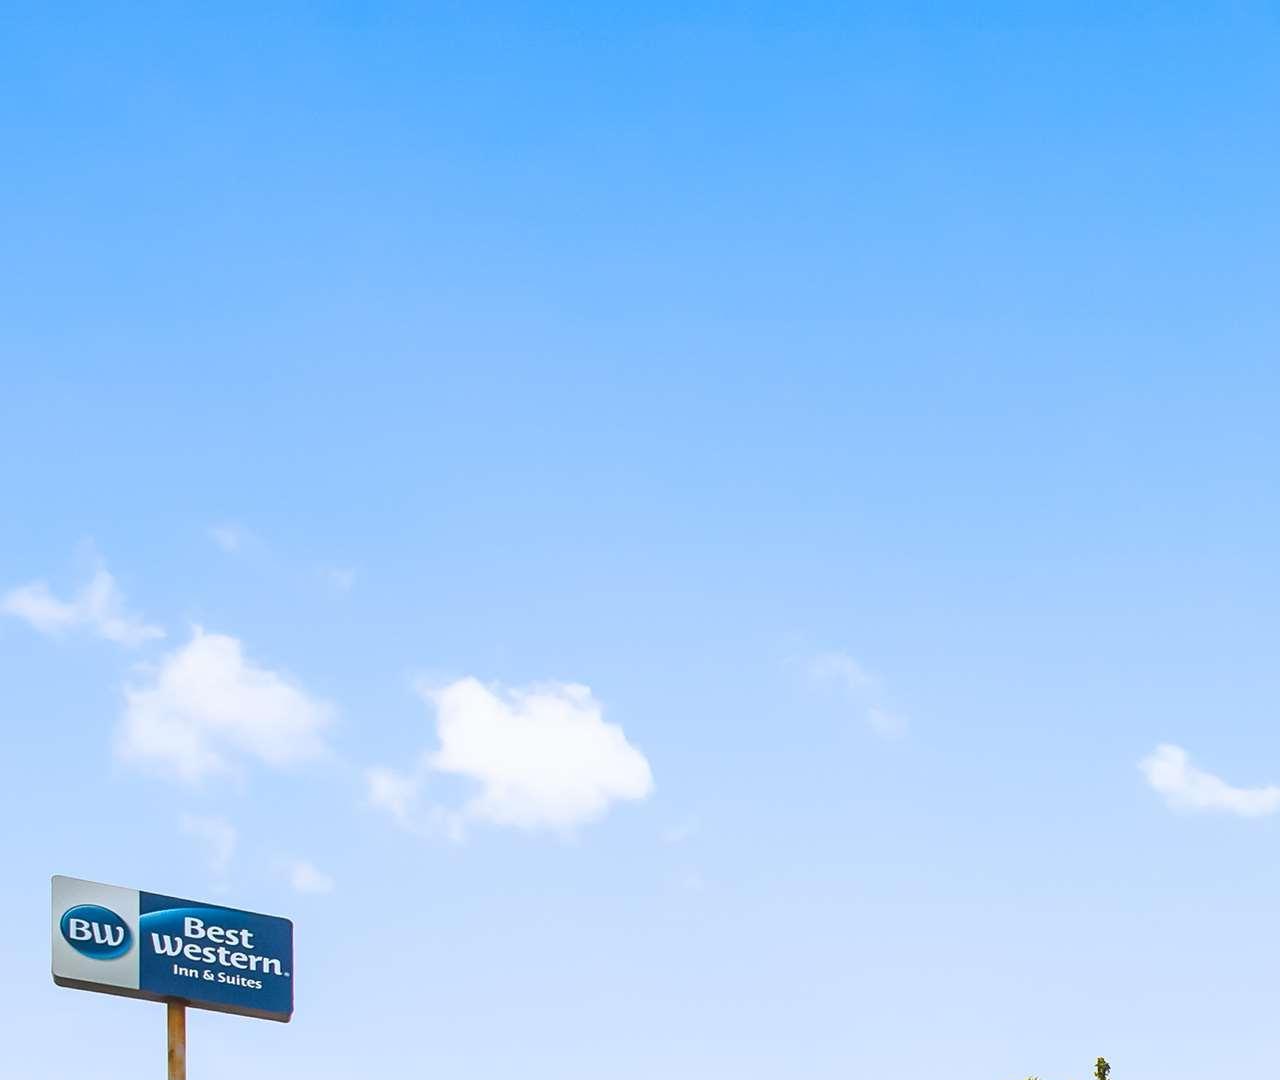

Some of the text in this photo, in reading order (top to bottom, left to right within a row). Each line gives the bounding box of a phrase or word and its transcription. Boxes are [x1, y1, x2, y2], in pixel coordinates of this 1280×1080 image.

[69, 917, 125, 947] BW
[184, 916, 254, 949] Best
[173, 964, 262, 990] Inn & Suites
